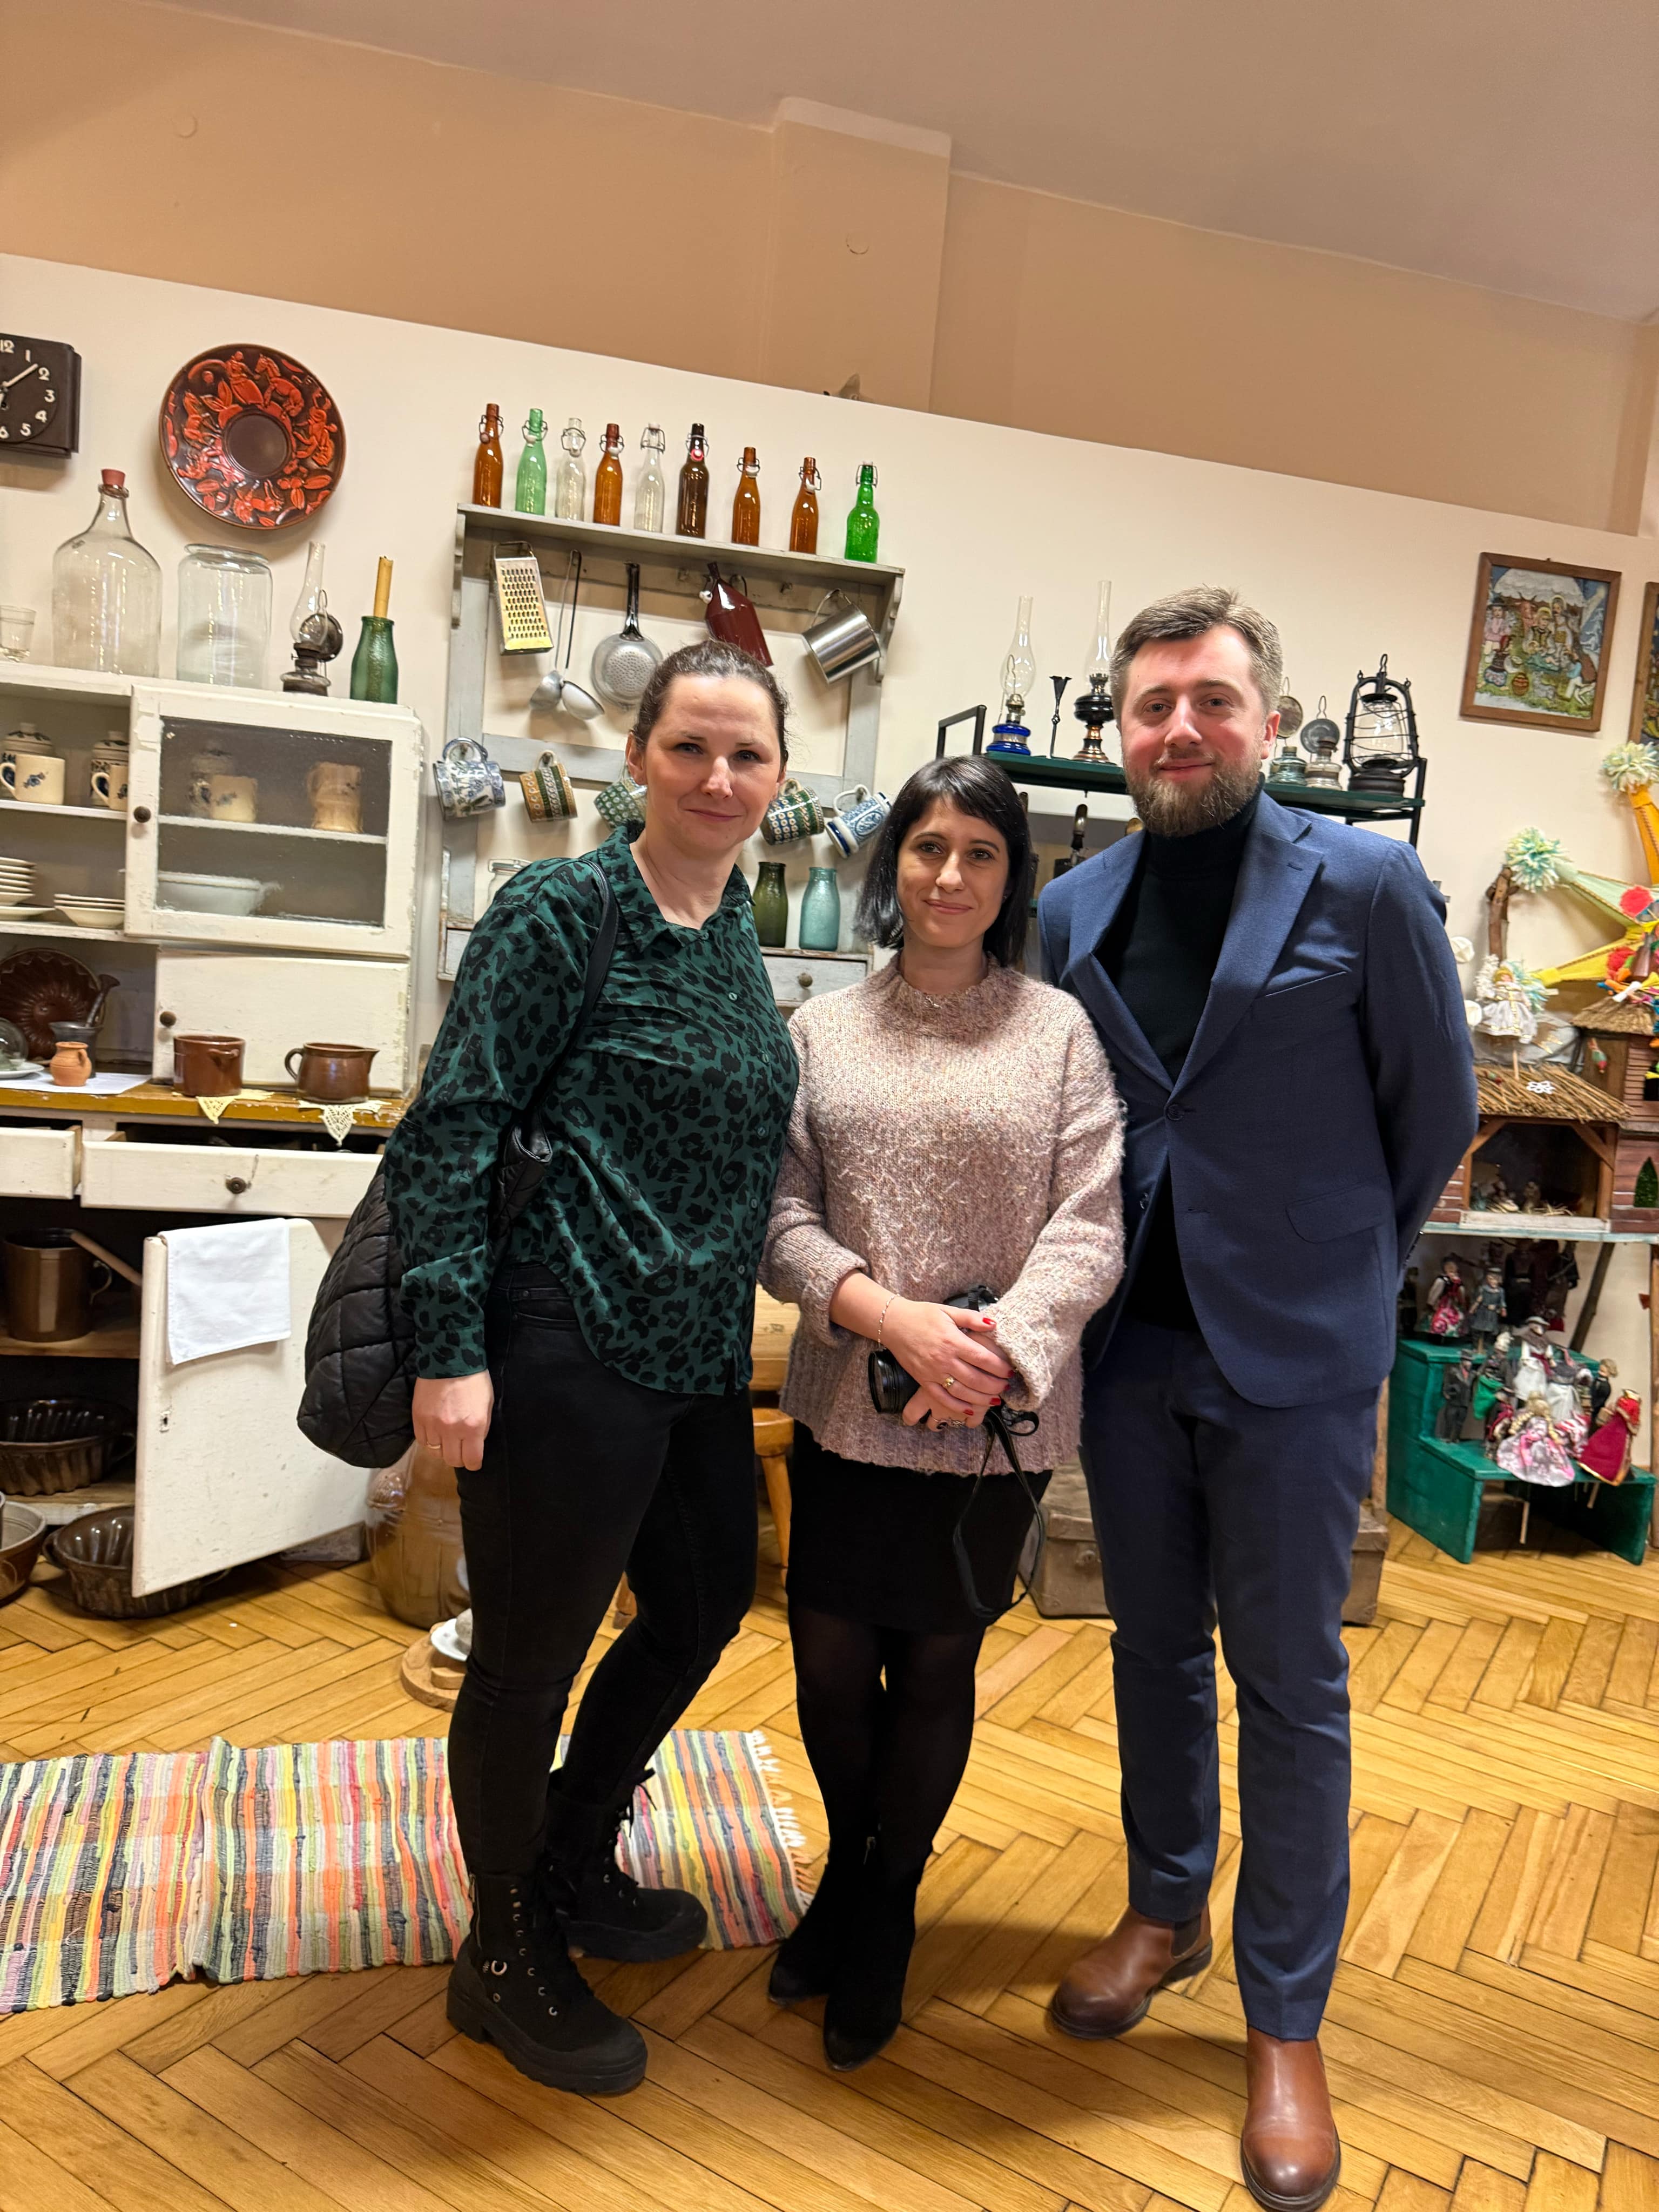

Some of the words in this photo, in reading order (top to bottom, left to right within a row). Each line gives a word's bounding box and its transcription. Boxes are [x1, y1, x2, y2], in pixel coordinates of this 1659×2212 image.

[25, 350, 31, 362] 1
[38, 367, 50, 381] 2
[44, 389, 55, 402] 3
[35, 410, 47, 423] 4
[0, 426, 9, 439] 6
[20, 423, 31, 436] 5
